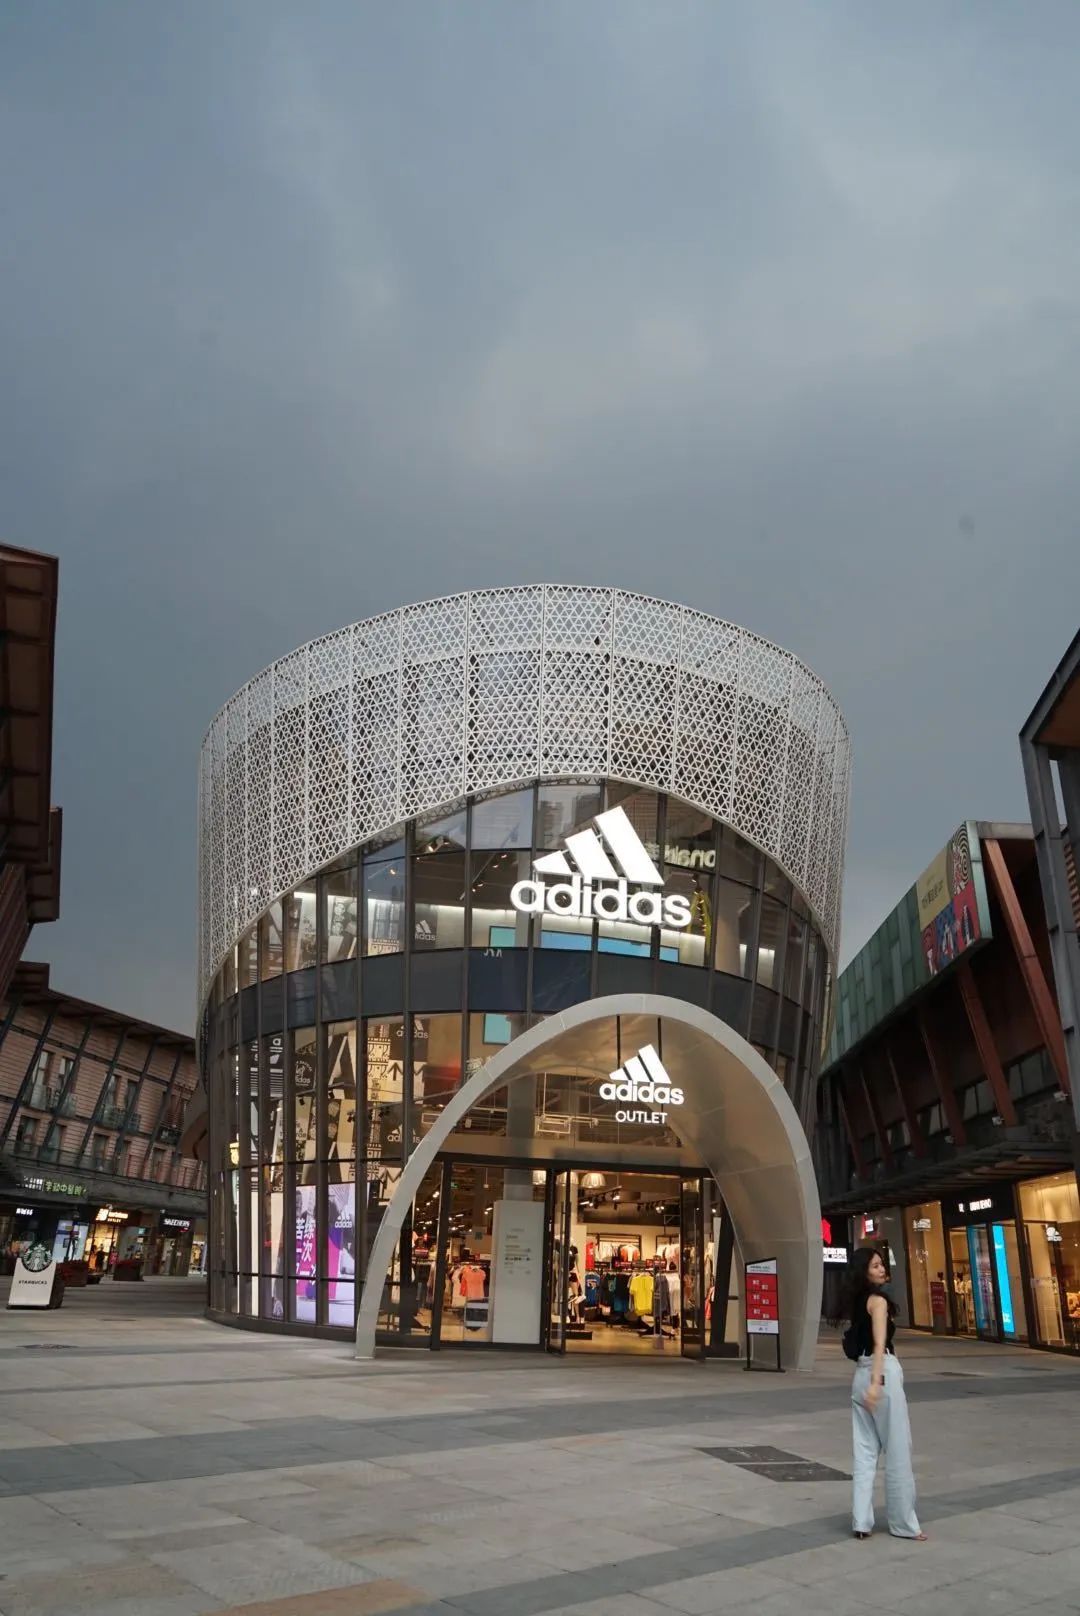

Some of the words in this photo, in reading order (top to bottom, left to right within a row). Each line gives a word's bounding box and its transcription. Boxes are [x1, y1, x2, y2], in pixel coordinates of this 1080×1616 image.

[510, 873, 692, 927] adidas
[599, 1080, 684, 1105] adidas
[615, 1110, 668, 1124] OUTLET
